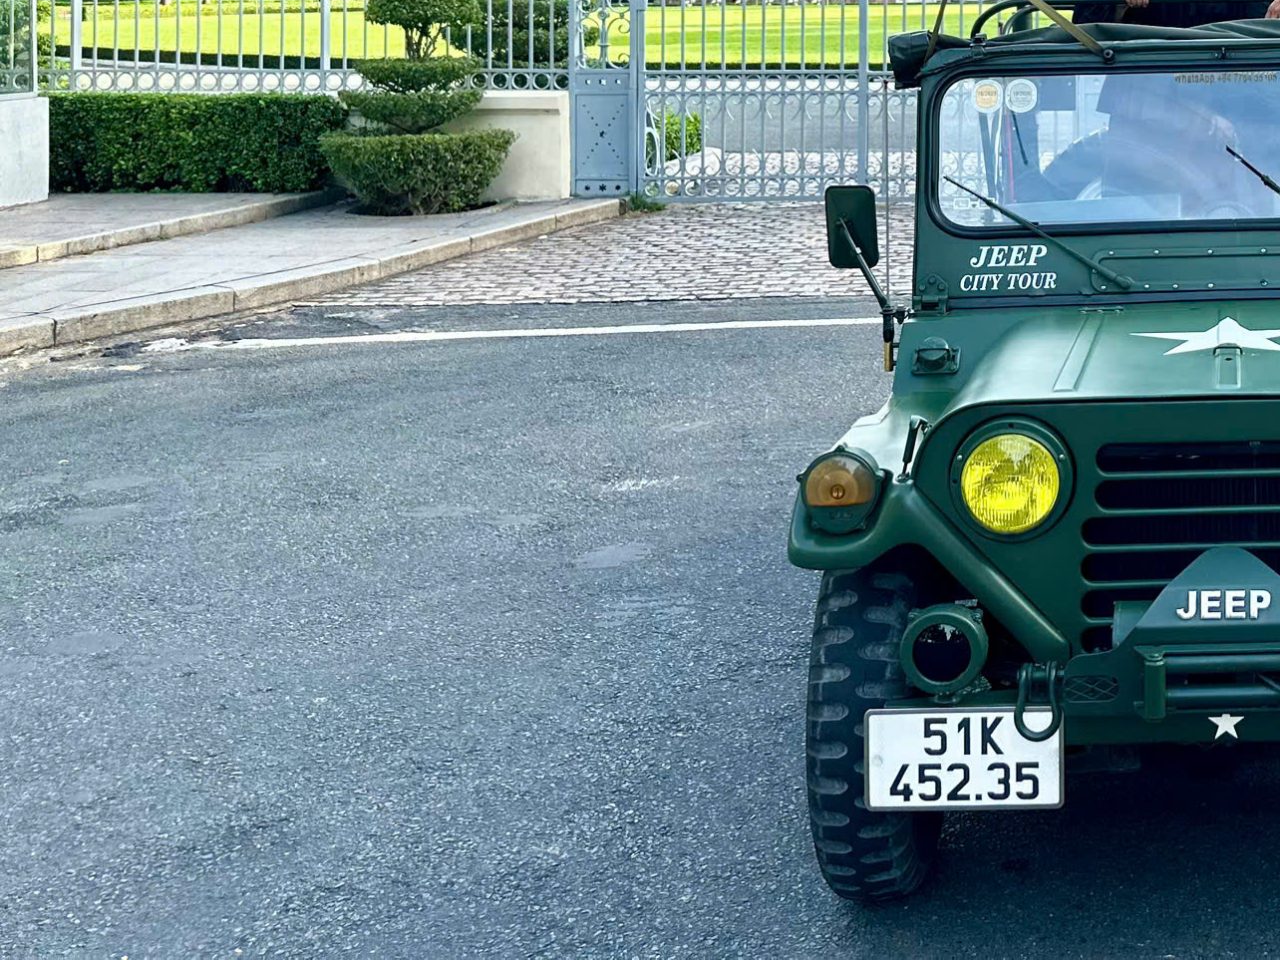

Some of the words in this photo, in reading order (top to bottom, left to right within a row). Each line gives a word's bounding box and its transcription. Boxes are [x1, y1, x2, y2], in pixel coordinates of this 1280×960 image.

[969, 244, 1048, 268] JEEP
[960, 273, 1004, 291] CITY
[1007, 272, 1057, 290] TOUR
[1176, 589, 1272, 620] JEEP
[923, 716, 1005, 756] 51K
[889, 761, 1040, 802] 452.35
